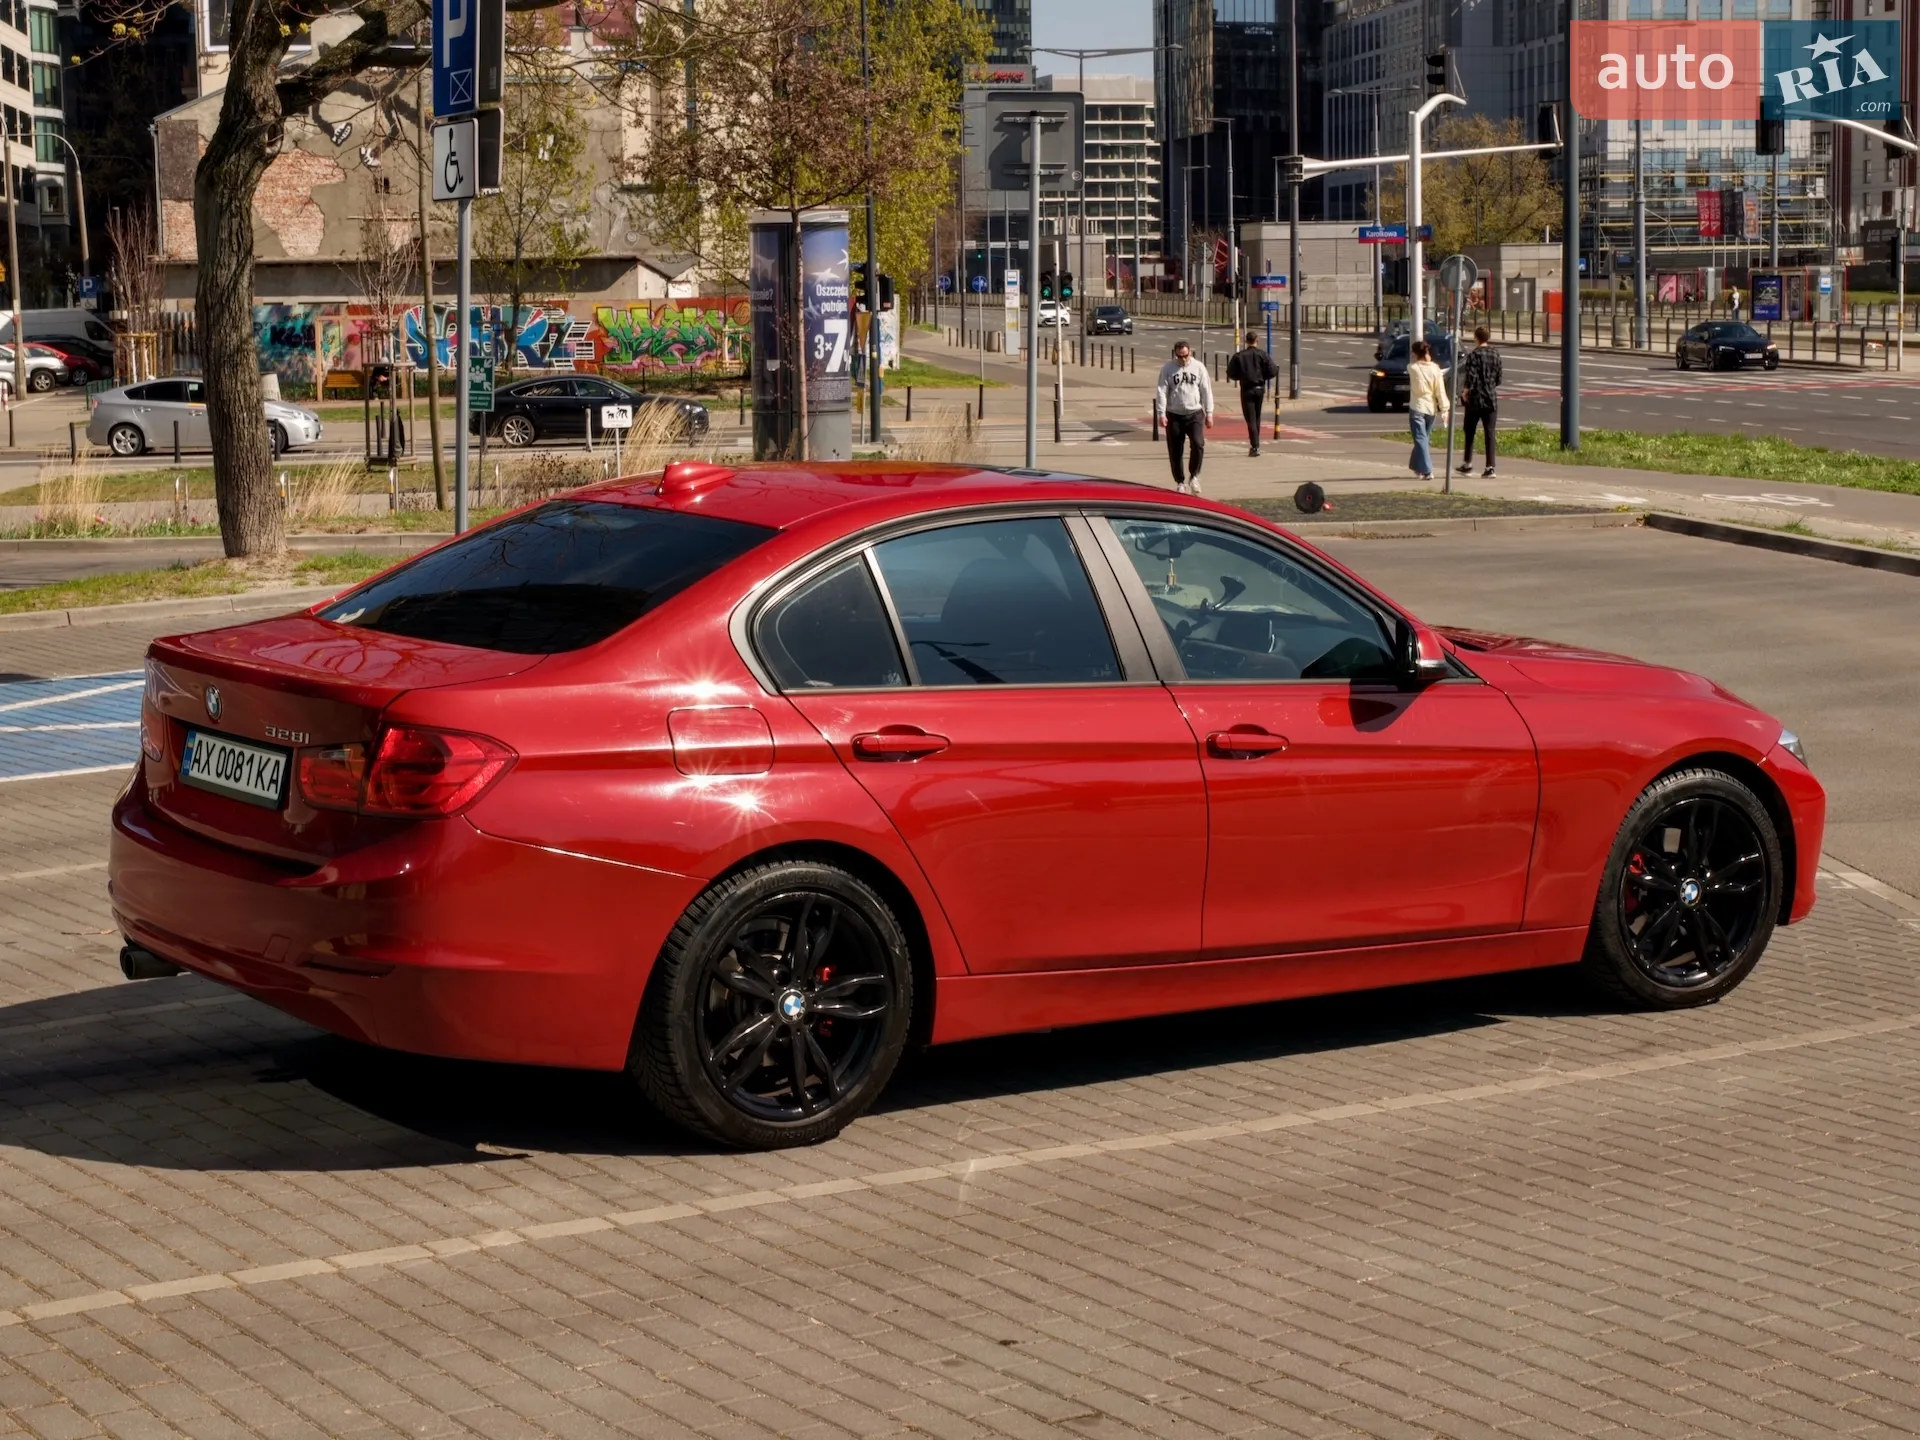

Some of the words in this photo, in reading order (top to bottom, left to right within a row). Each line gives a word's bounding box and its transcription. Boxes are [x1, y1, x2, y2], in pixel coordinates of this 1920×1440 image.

[443, 0, 468, 68] P
[83, 279, 93, 292] P
[1173, 372, 1197, 385] GAP
[215, 745, 254, 787] 0081
